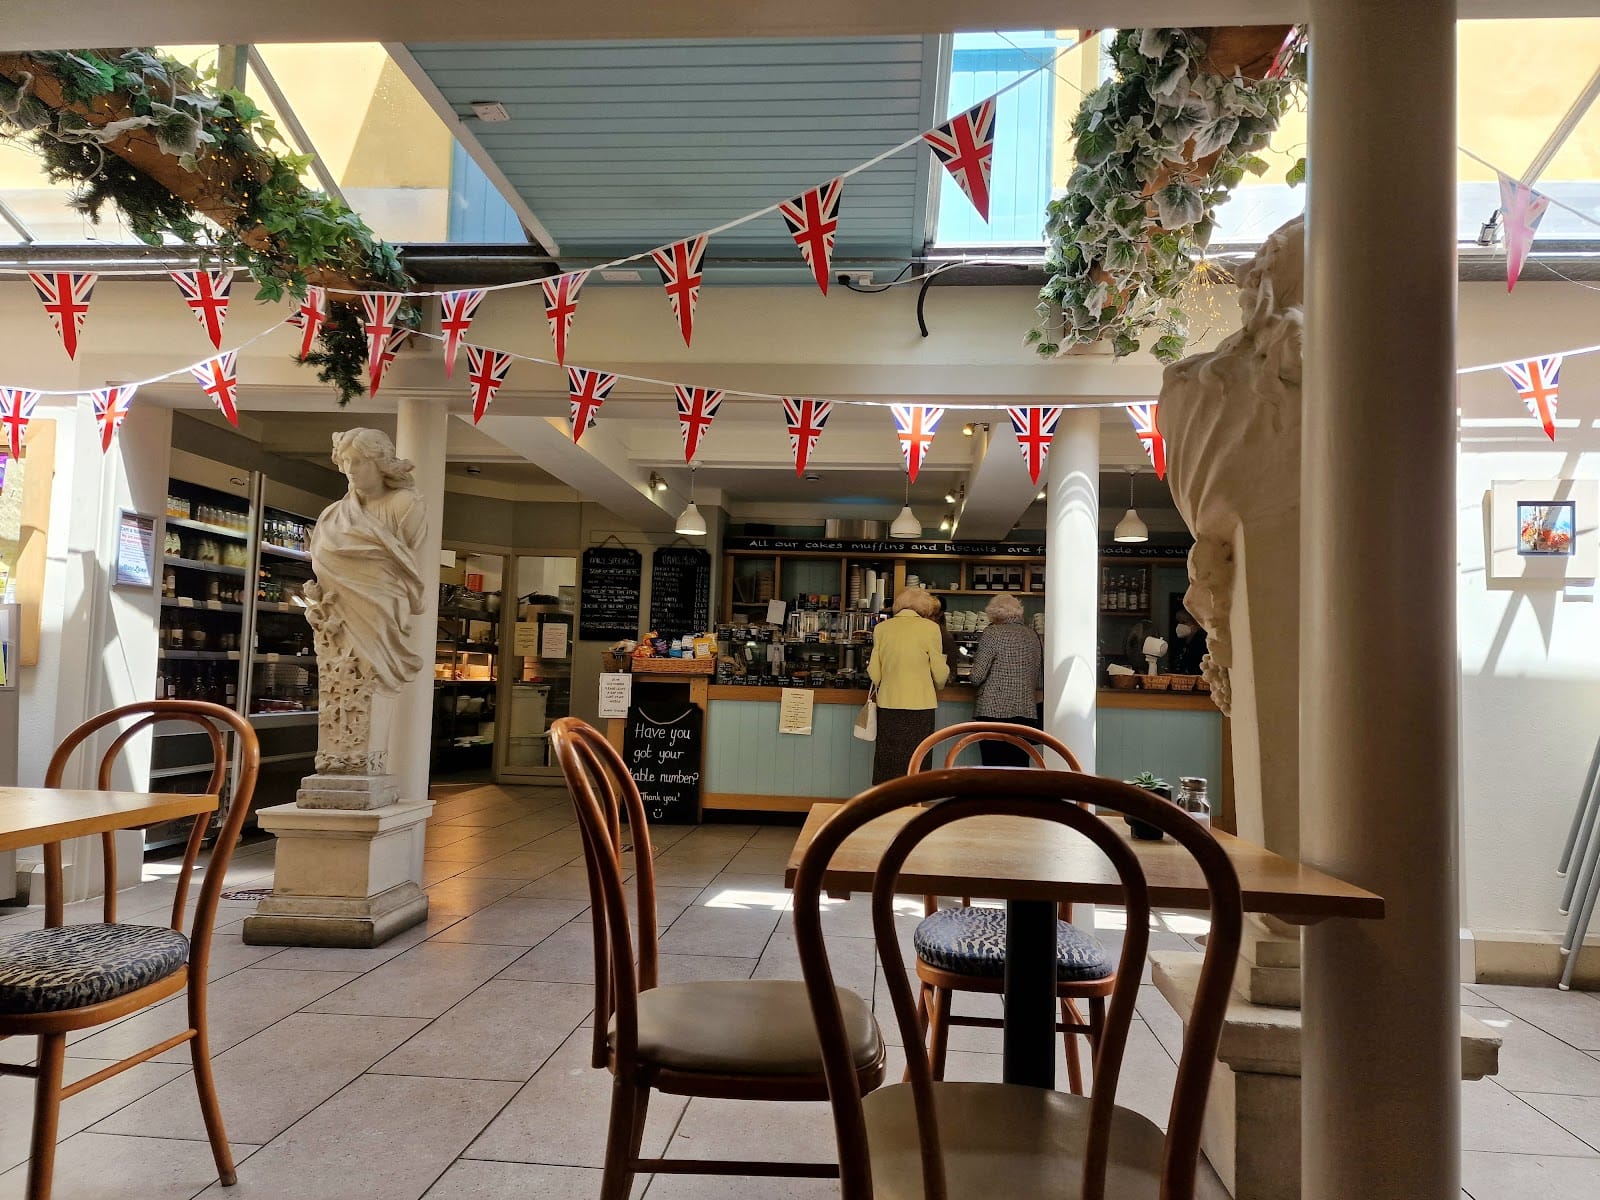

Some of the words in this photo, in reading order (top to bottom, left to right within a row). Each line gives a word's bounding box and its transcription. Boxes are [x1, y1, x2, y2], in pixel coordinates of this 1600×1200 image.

[774, 542, 799, 550] our
[804, 542, 843, 550] cakes
[851, 543, 905, 552] muffins
[911, 543, 937, 551] and
[944, 543, 997, 553] biscuits
[1098, 545, 1132, 554] ade
[635, 722, 666, 739] Have
[669, 728, 690, 747] you
[633, 743, 653, 763] got
[657, 750, 685, 764] your
[660, 769, 699, 786] number?
[640, 791, 661, 801] Thank
